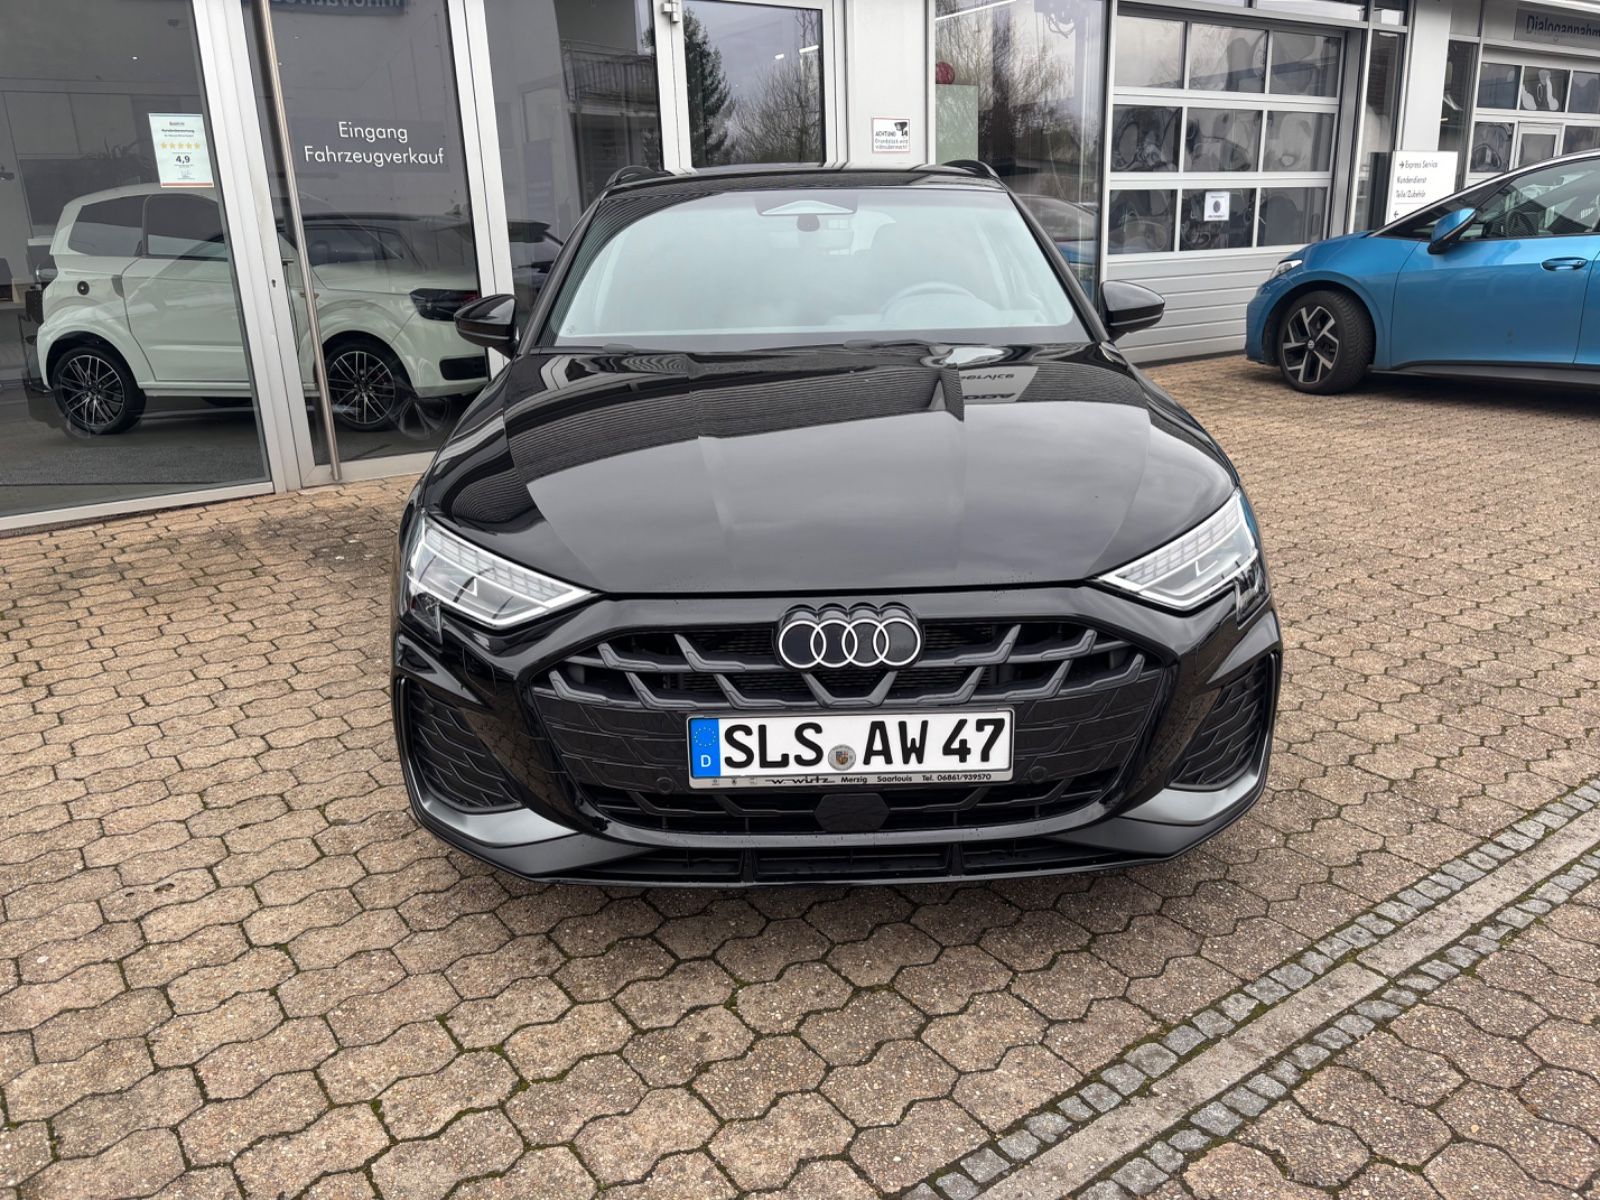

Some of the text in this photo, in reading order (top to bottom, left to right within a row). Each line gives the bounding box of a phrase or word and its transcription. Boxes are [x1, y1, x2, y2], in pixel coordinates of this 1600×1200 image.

[338, 121, 408, 143] Eingang
[176, 155, 190, 164] 4,9
[304, 145, 445, 168] Fahrzeugverkauf
[1422, 160, 1438, 168] Service
[724, 718, 1005, 768] SLS AW 47
[701, 755, 711, 767] D
[840, 776, 867, 785] Merzig
[877, 775, 912, 783] Saarlouis
[937, 773, 992, 782] 06861/939570
